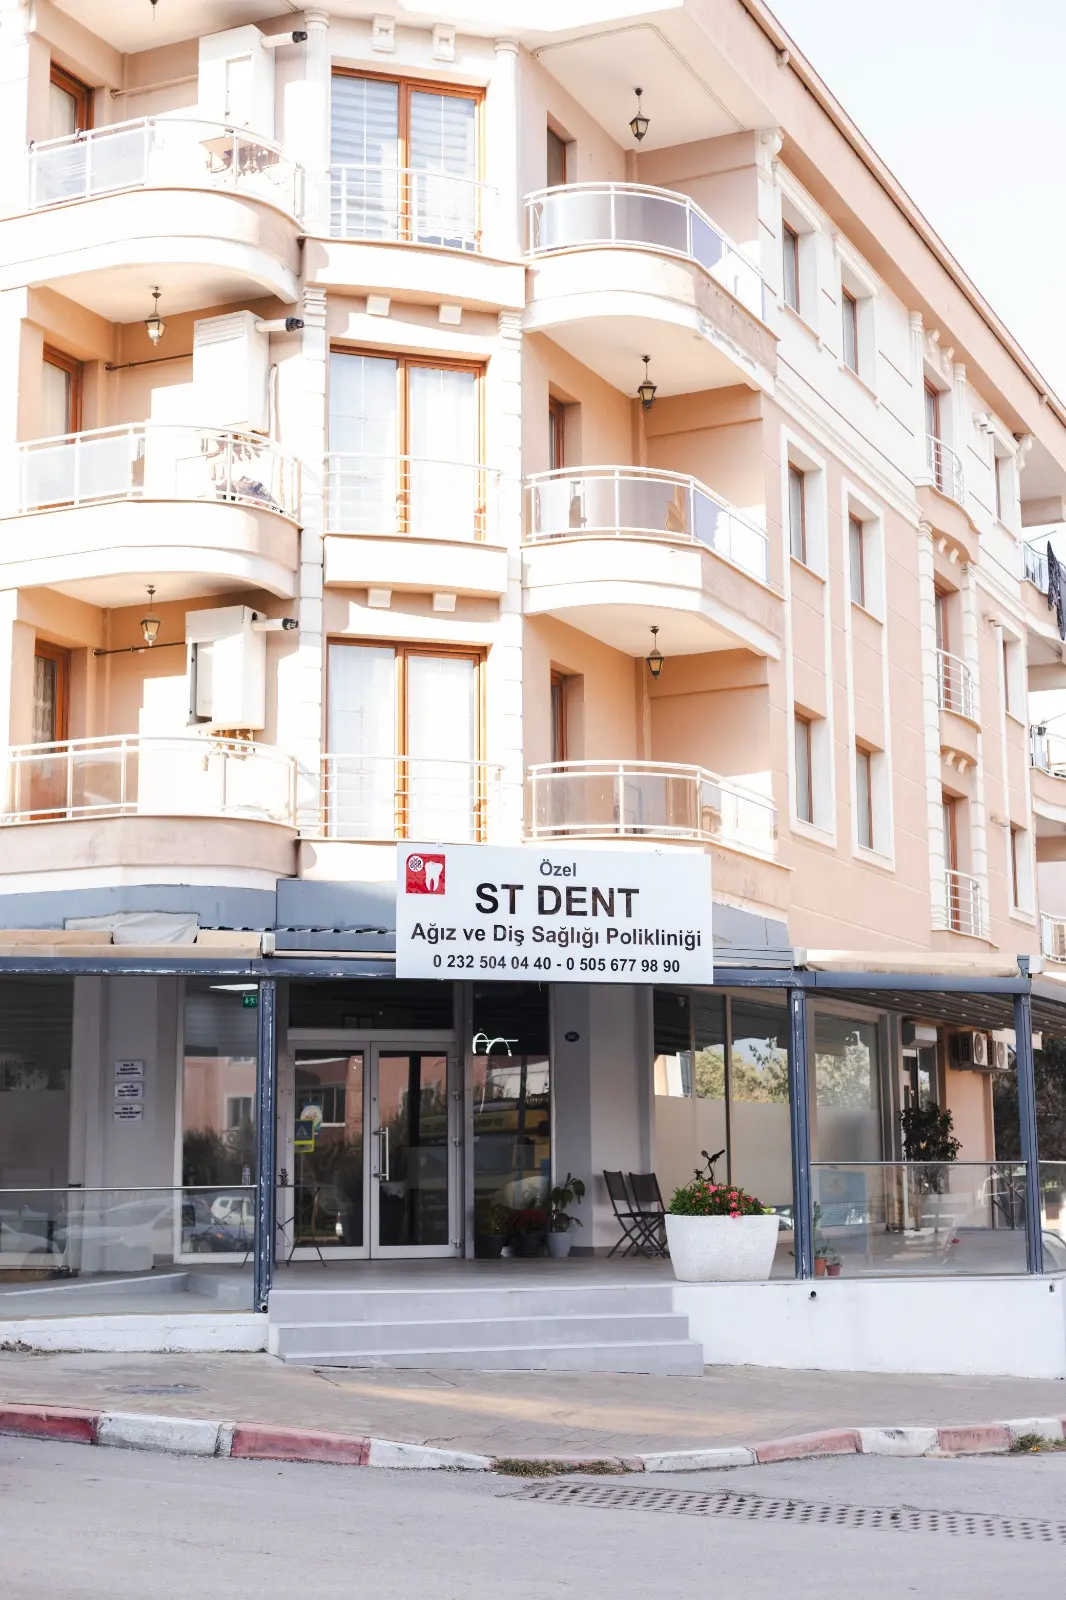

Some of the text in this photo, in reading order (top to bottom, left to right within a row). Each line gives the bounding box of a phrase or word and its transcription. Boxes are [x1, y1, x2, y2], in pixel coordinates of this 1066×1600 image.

[539, 858, 577, 877] Özel
[475, 882, 640, 919] ST DENT
[410, 922, 701, 952] Ağız ve Diş Sağlığı Polikliniği
[432, 954, 442, 968] 0
[446, 954, 475, 969] 232
[479, 955, 507, 970] 504
[510, 955, 530, 970] 04
[533, 956, 552, 971] 40
[566, 957, 575, 971] 0
[579, 957, 606, 972] 505
[610, 958, 637, 972] 677
[641, 958, 659, 973] 98
[662, 959, 681, 973] 90
